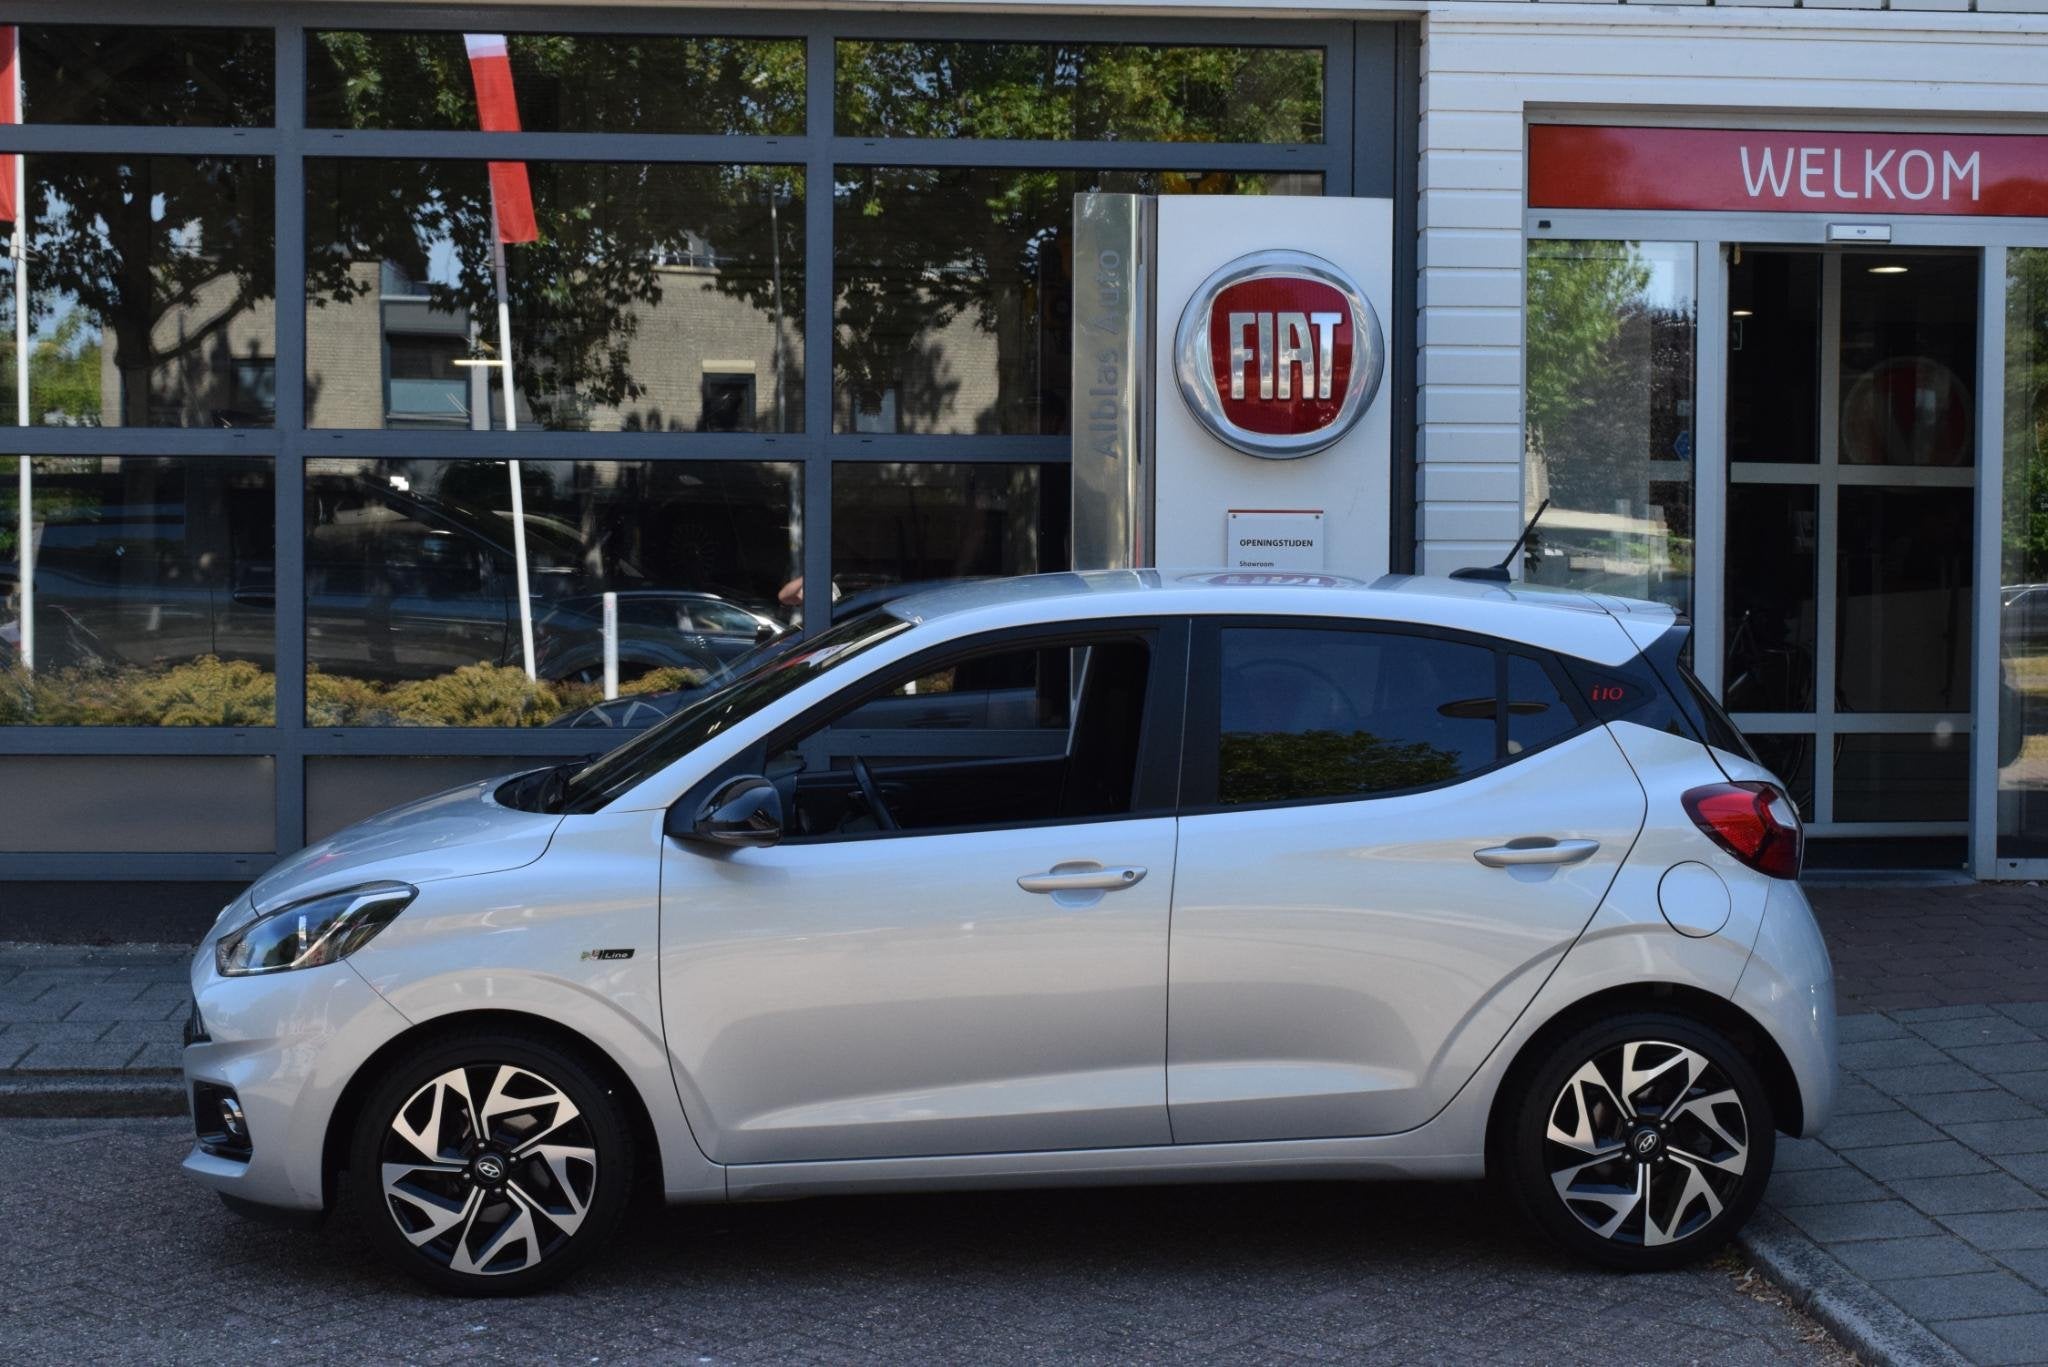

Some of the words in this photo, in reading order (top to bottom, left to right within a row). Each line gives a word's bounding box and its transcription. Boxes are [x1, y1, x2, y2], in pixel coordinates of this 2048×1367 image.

[1740, 146, 1981, 201] WELKOM
[1090, 250, 1121, 335] Auto
[1229, 312, 1342, 400] FIAT
[1088, 350, 1119, 460] Alblas
[1239, 539, 1314, 548] OPENINGSTIJDEN
[1239, 560, 1275, 568] Showroom
[1592, 684, 1625, 700] i10
